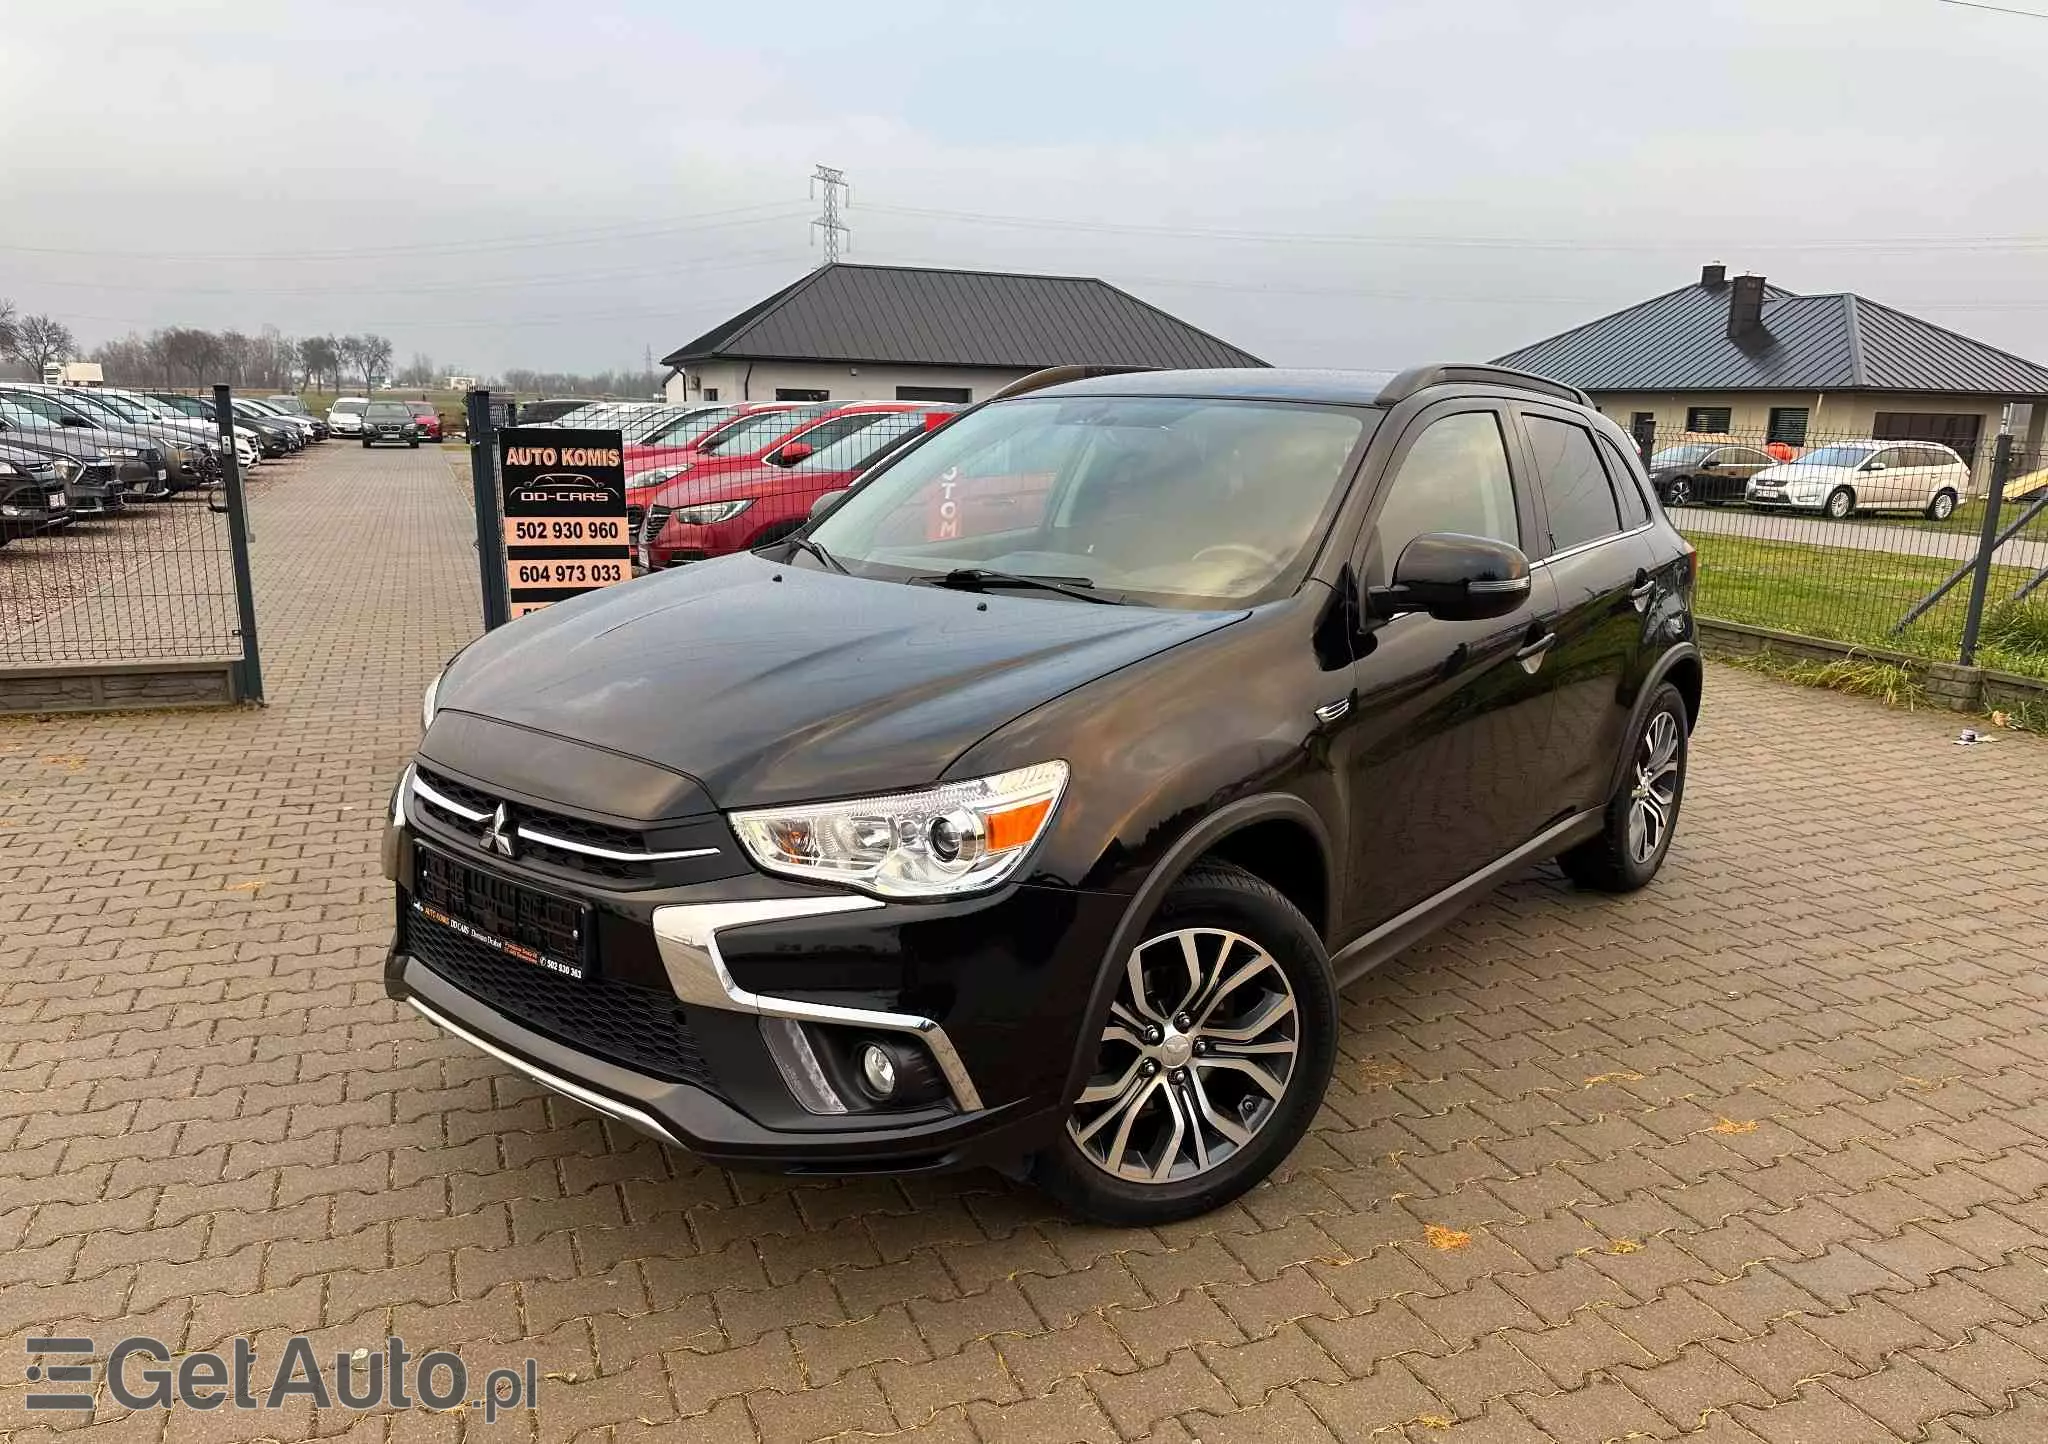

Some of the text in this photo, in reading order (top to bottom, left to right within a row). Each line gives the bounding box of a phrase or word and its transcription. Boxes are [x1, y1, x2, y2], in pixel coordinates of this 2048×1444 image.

[506, 447, 621, 467] AUTO KOMIS
[516, 522, 618, 539] 502 930 960
[519, 564, 621, 583] 604 973 033
[547, 959, 558, 970] 502
